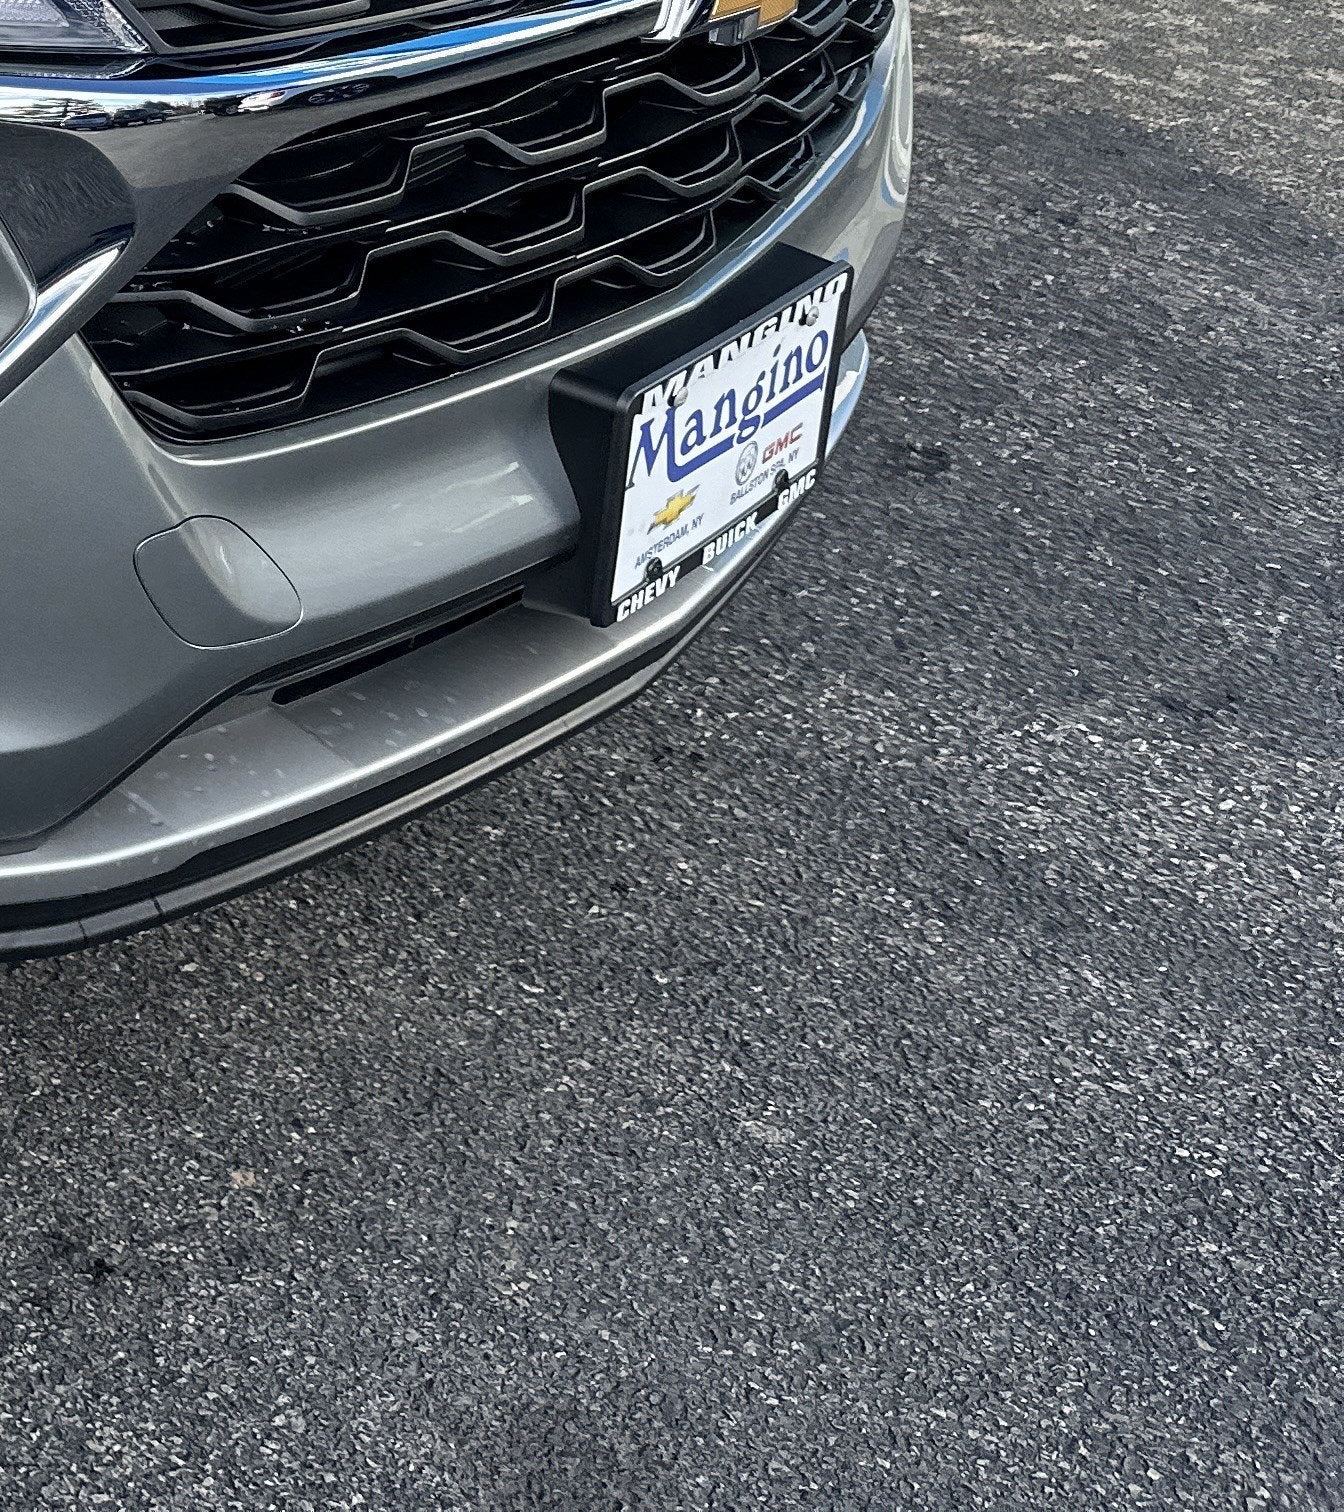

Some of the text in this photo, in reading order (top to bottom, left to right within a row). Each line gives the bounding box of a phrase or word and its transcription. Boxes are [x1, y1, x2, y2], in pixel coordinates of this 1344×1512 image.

[642, 272, 849, 415] MANGINO
[625, 329, 829, 488] Mangino
[762, 422, 804, 464] GMC
[788, 447, 800, 463] NY
[616, 468, 816, 622] CHEVY BUICK GMC
[692, 513, 704, 529] NY
